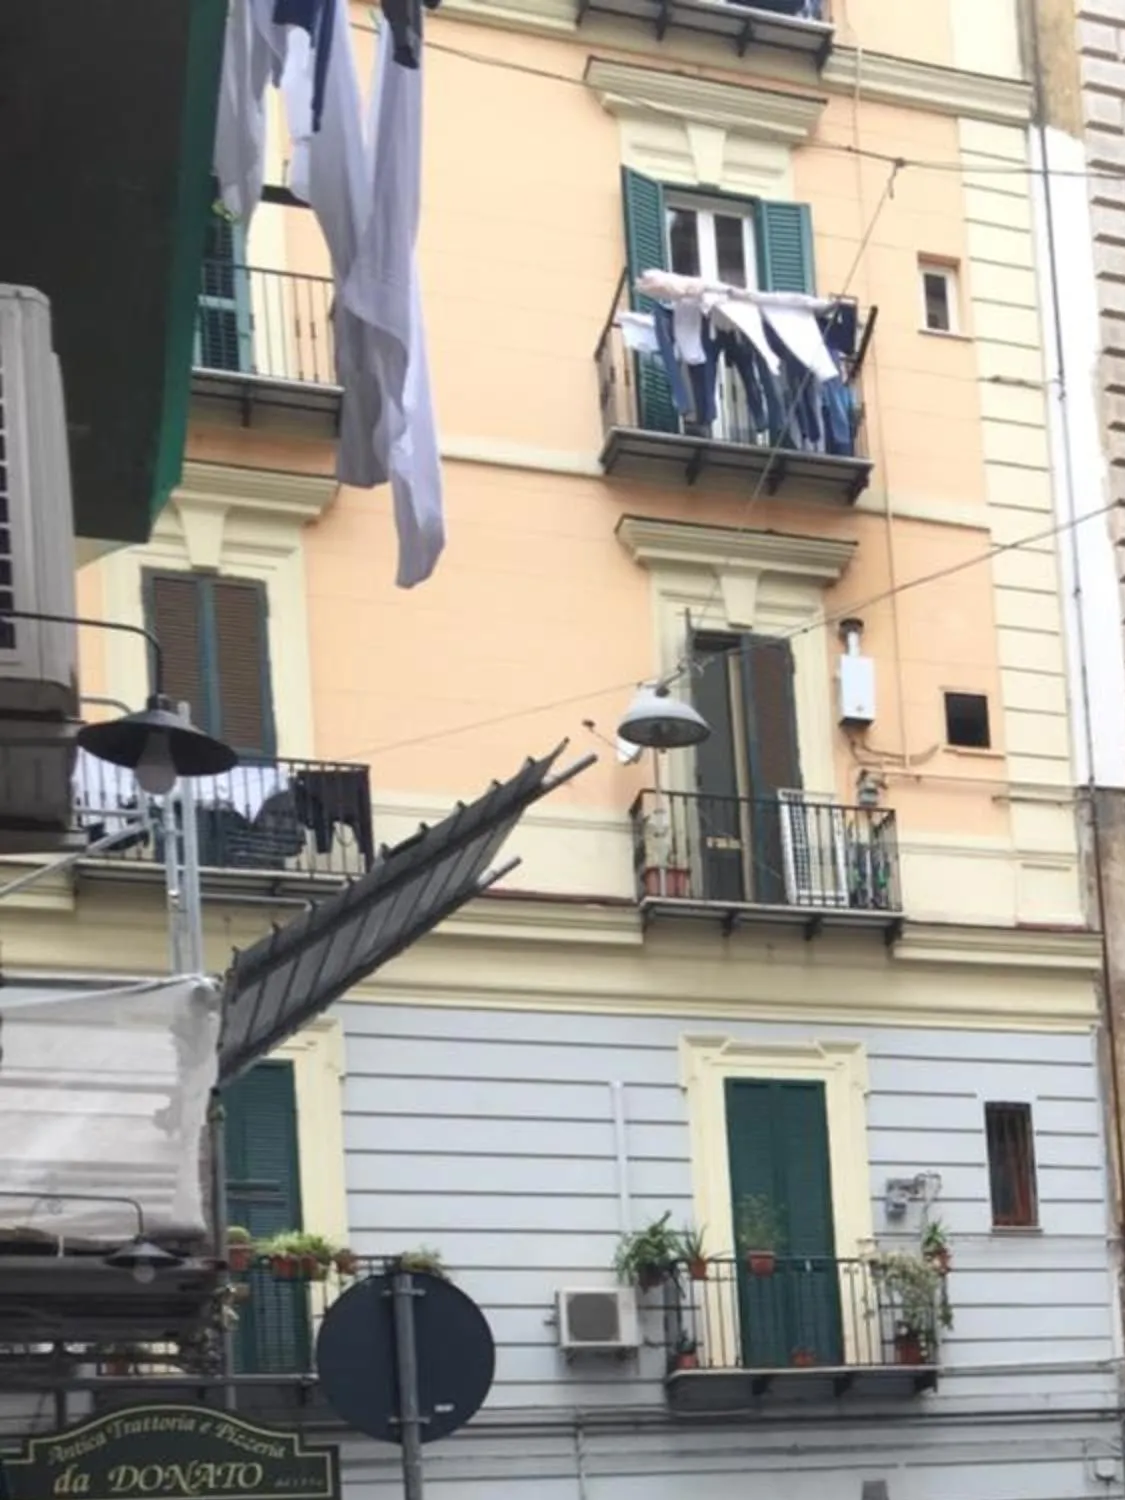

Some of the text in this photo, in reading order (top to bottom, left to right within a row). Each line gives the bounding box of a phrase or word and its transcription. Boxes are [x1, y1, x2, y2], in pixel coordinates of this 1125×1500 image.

[48, 1413, 286, 1463] Antica Trattoria e Pizzeria
[54, 1459, 264, 1496] da DONATO
